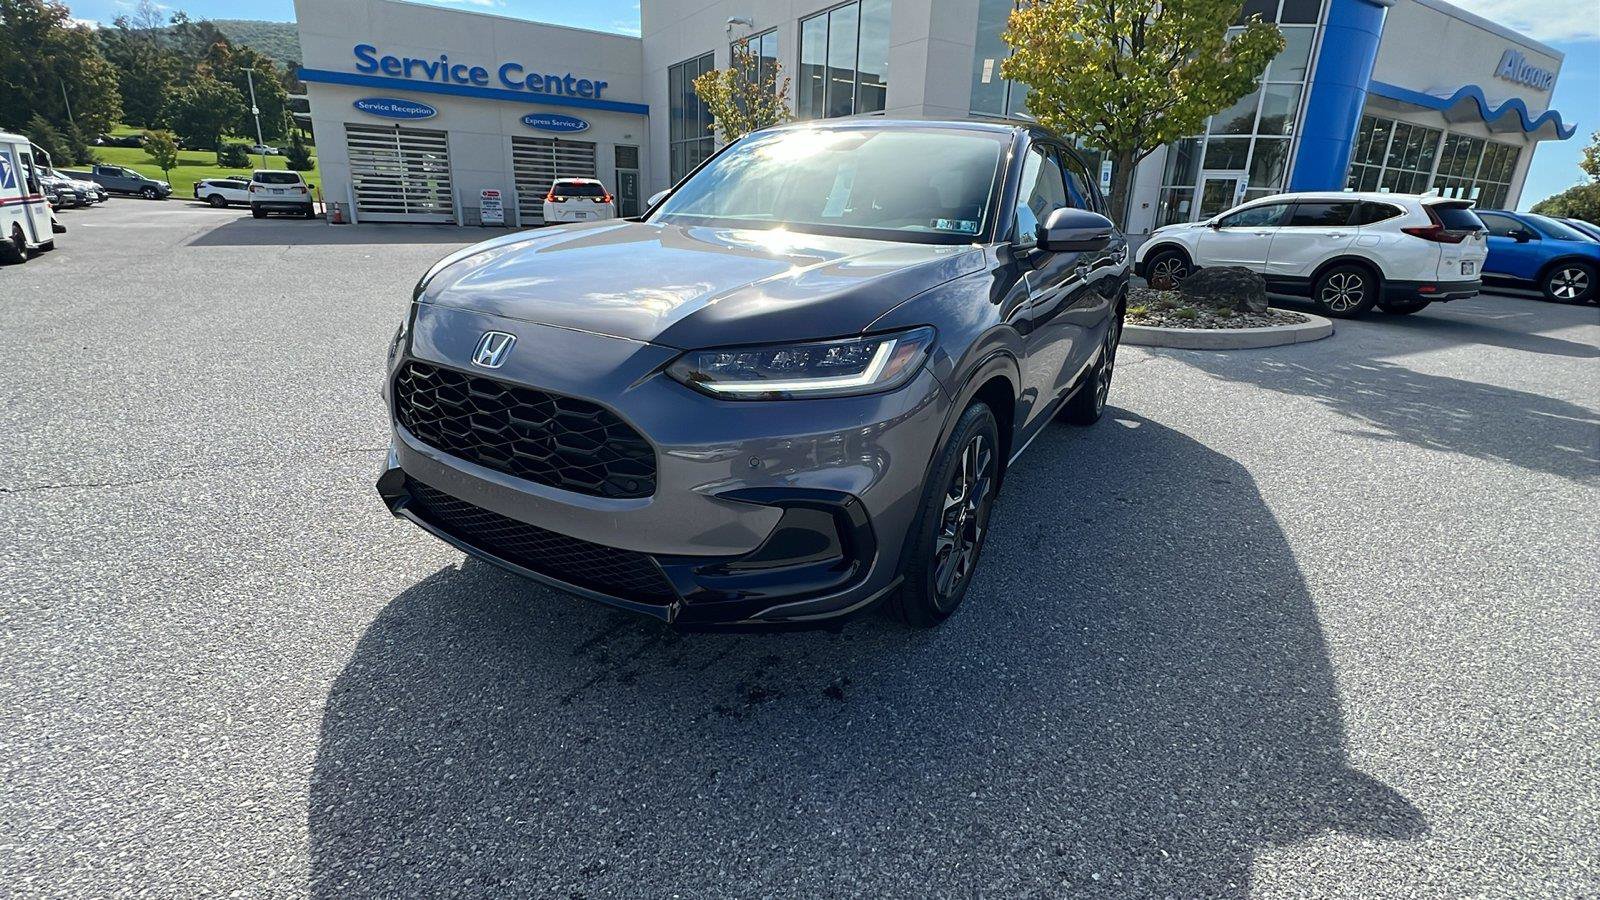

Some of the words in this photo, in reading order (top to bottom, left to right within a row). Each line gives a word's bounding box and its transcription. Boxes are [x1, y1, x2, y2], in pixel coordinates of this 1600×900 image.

[354, 44, 489, 84] Service
[498, 62, 608, 99] Center
[1494, 49, 1553, 90] Altoona
[358, 101, 390, 111] Service
[391, 104, 432, 115] Reception
[525, 117, 551, 126] Express
[551, 119, 576, 128] Service
